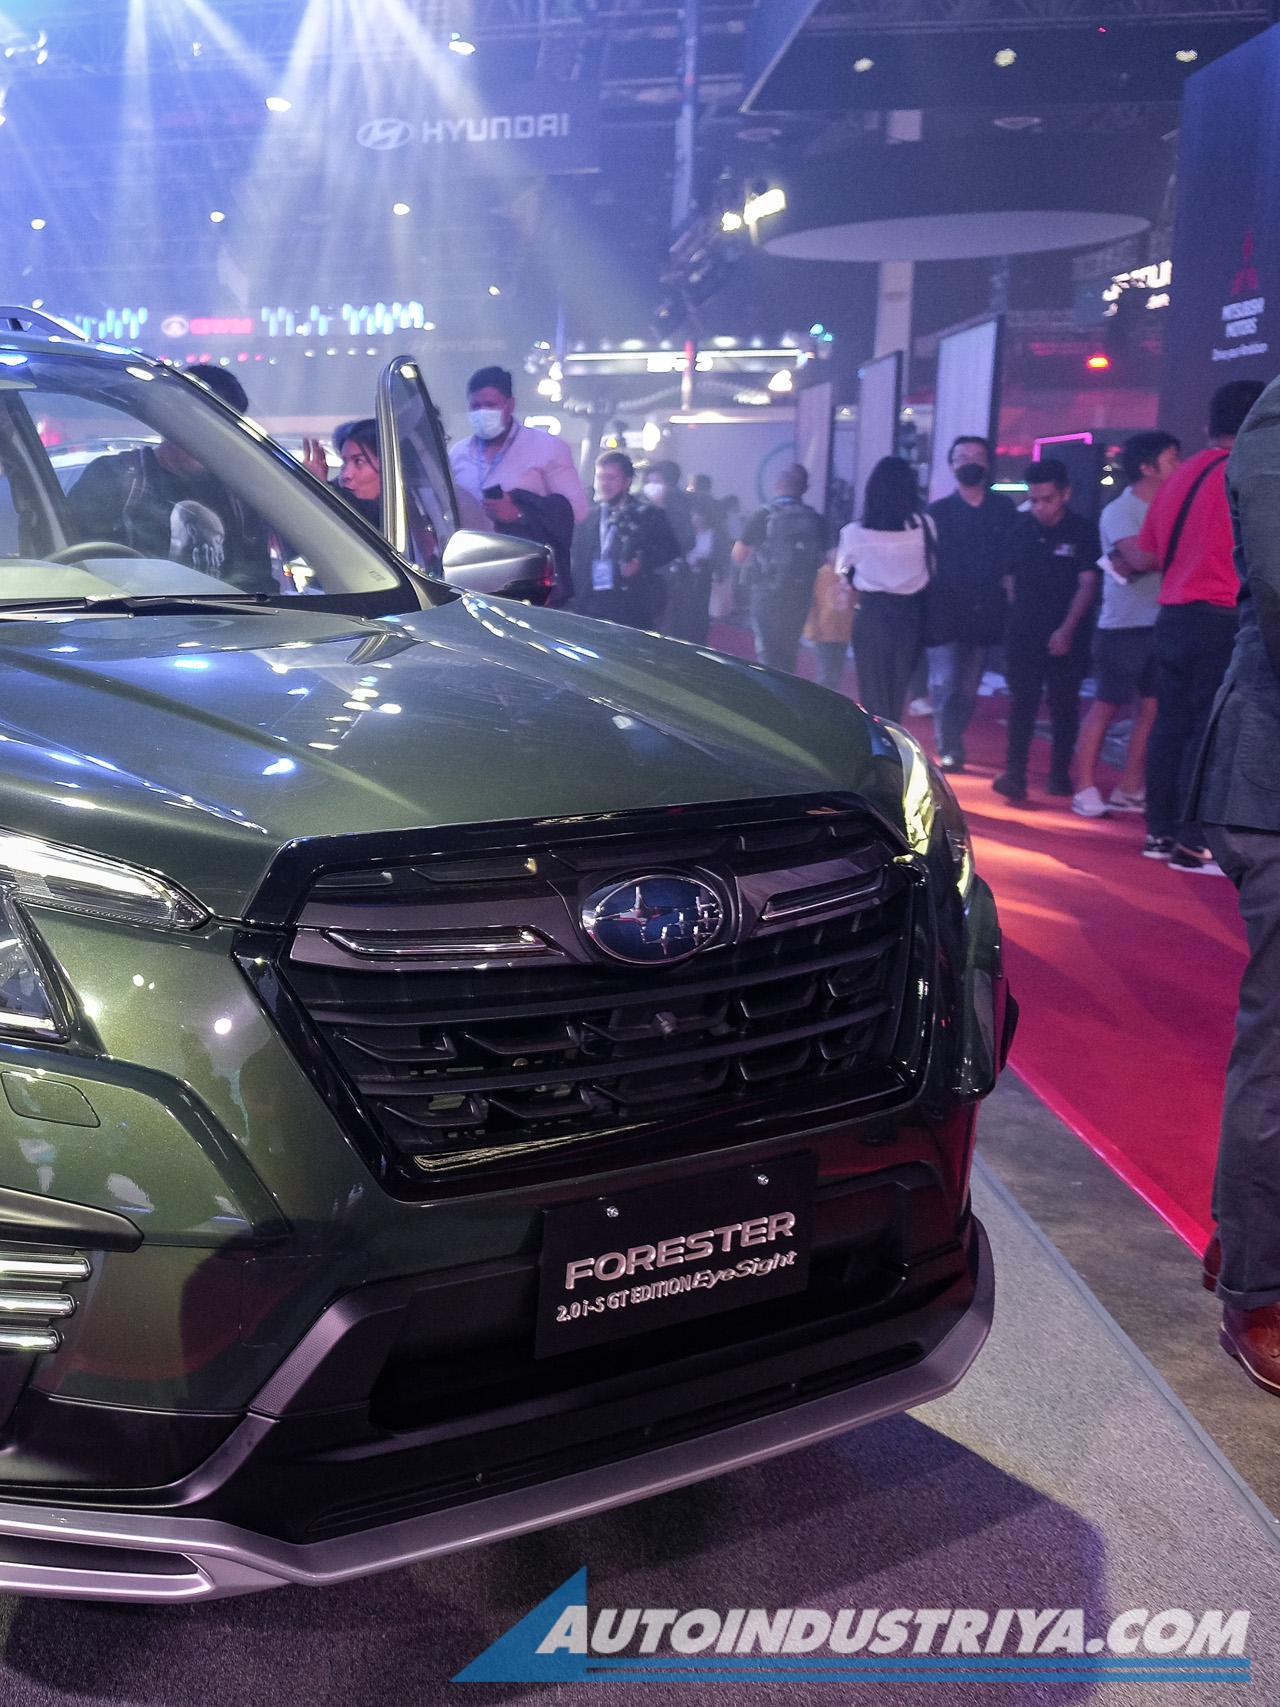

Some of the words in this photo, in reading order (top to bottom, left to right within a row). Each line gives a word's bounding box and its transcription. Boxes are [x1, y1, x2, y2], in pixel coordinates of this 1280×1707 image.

[422, 113, 569, 143] HYUNDAI
[565, 1211, 796, 1290] FORESTER
[606, 1289, 631, 1310] GT
[630, 1273, 692, 1305] EDITION
[691, 1250, 798, 1289] EyeSight
